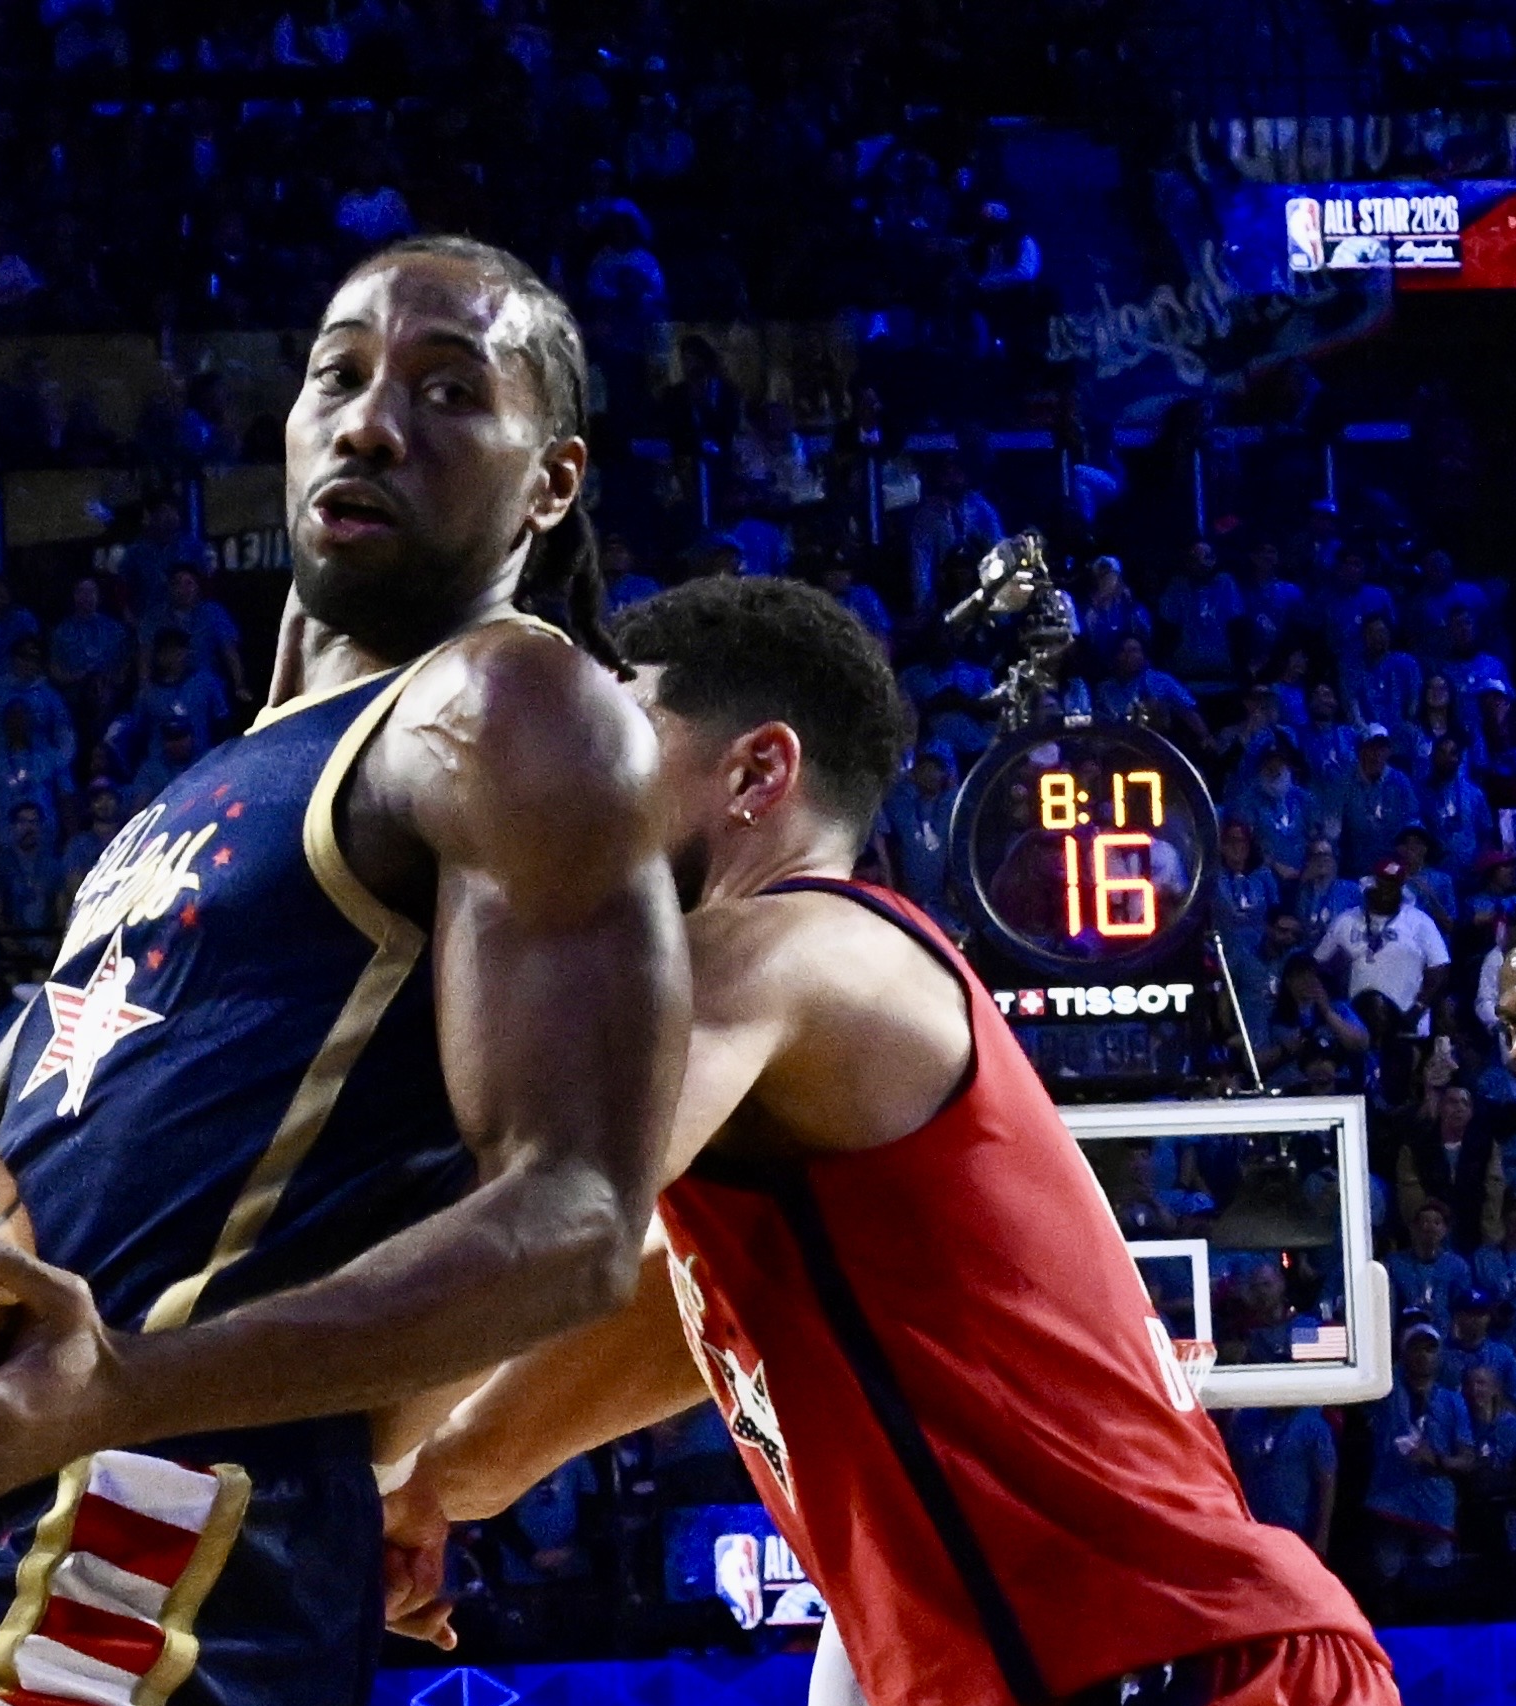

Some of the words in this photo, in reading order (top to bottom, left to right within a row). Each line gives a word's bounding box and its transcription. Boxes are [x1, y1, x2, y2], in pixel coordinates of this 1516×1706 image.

[1324, 199, 1356, 235] ALL
[1358, 197, 1409, 235] STAR
[1409, 195, 1459, 233] 2026
[1040, 771, 1163, 829] 8:17
[1065, 834, 1156, 937] 16
[1047, 983, 1194, 1016] TISSOT
